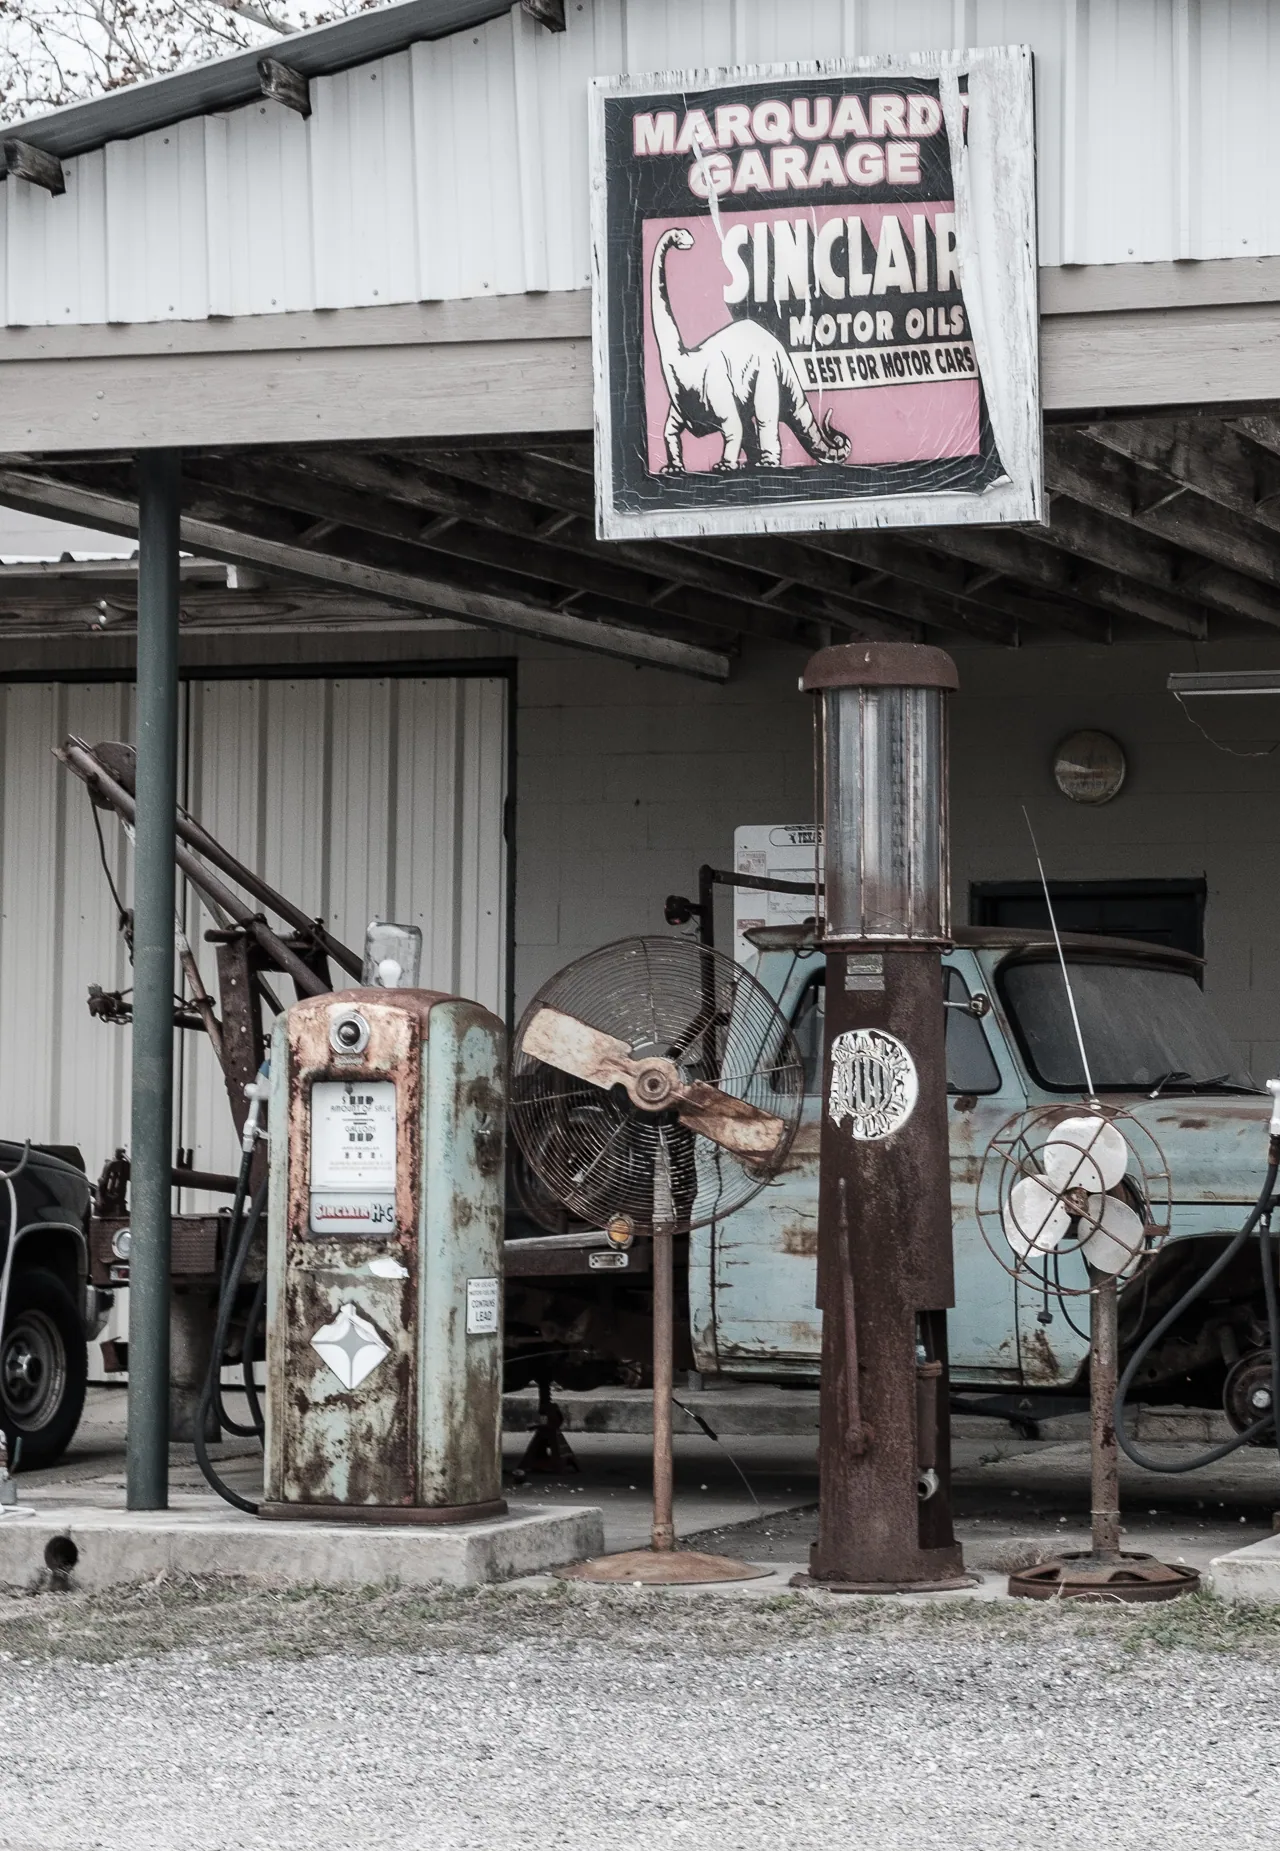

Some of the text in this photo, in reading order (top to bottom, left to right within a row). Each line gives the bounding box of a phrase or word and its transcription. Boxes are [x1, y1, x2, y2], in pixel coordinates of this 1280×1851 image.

[633, 93, 968, 156] MARQUARD
[688, 141, 922, 198] GARAGE
[722, 213, 962, 303] SINCLAIR
[789, 305, 965, 346] MOTOR OILS
[803, 346, 976, 384] BEST FOR MOTOR CARS
[315, 1203, 370, 1220] SINCLAIR
[475, 1310, 492, 1322] LEAD
